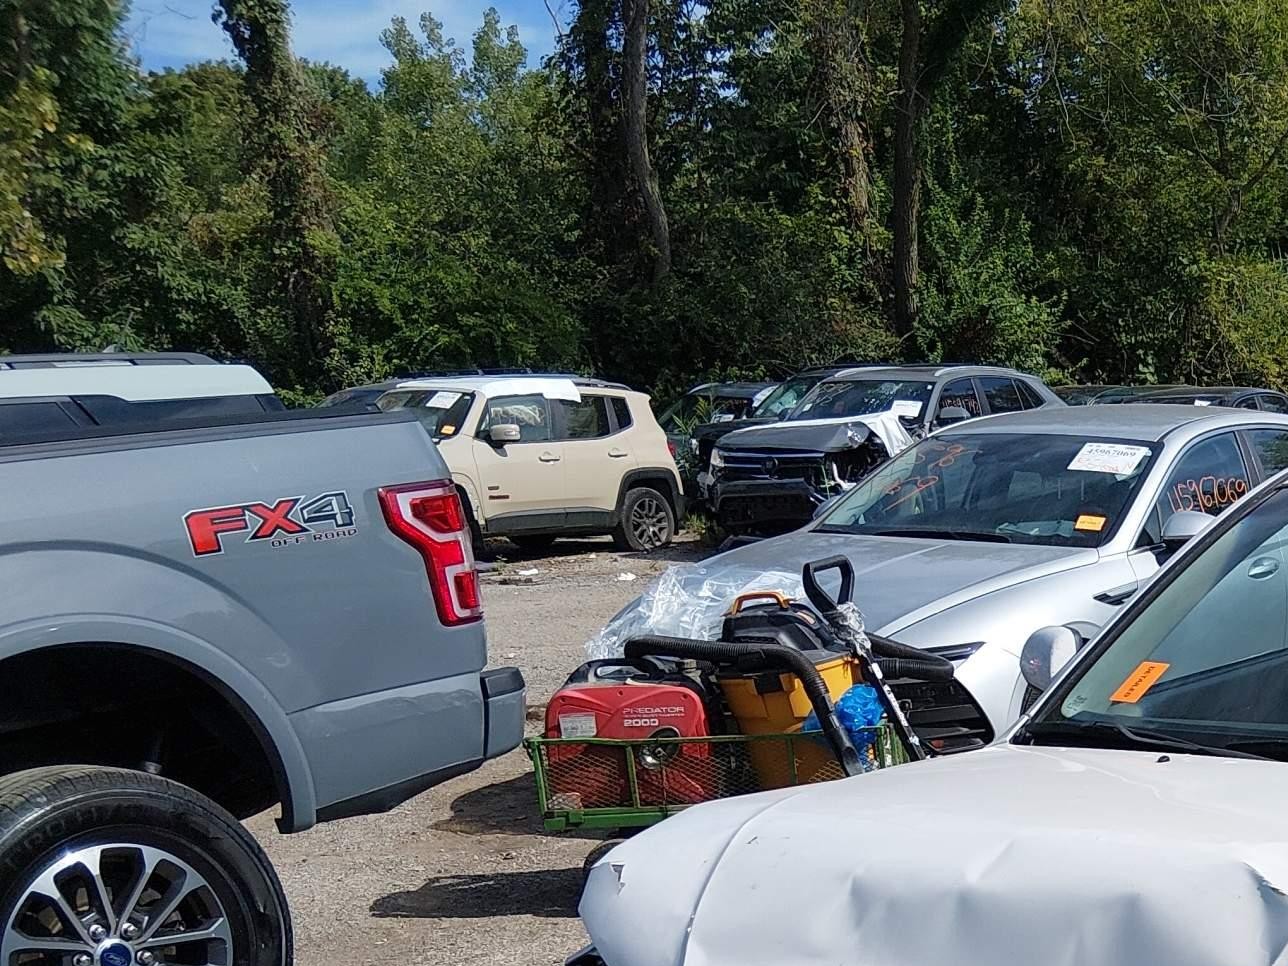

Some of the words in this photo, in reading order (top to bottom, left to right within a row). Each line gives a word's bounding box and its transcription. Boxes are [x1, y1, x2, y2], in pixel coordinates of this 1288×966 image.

[182, 490, 356, 558] FX4
[271, 536, 306, 548] OFF
[313, 528, 358, 543] ROAD
[623, 706, 685, 714] PREDATOR
[623, 718, 659, 727] 2000
